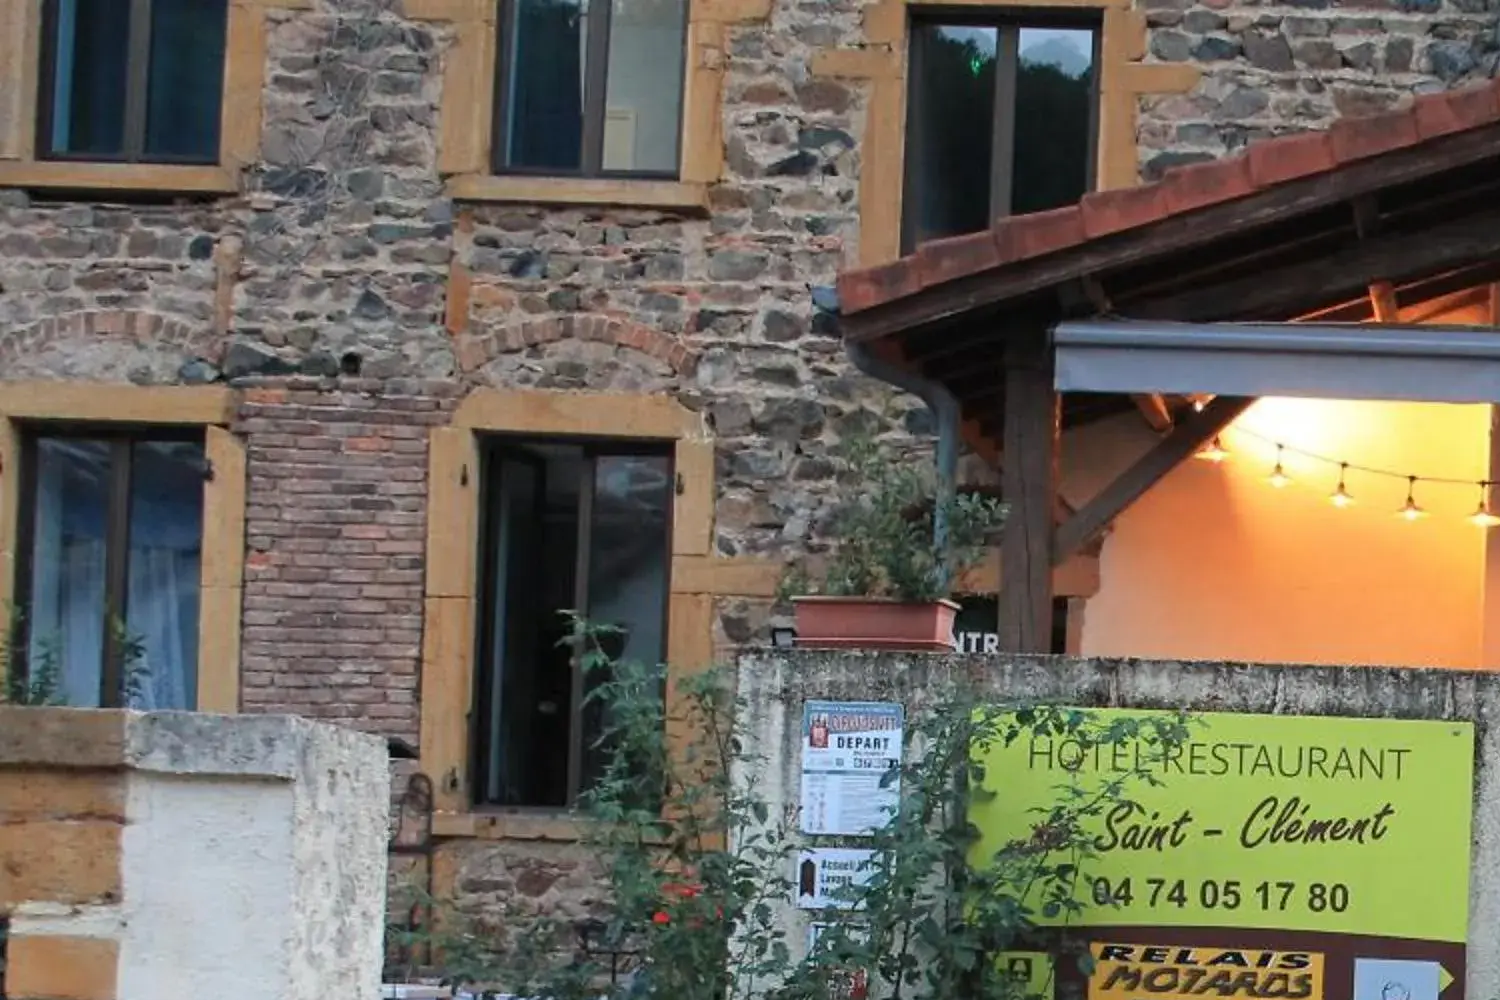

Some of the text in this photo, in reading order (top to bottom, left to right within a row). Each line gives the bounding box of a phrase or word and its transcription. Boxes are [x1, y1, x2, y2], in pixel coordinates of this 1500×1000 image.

[1028, 738, 1412, 781] HOTEL RESTAURANT
[1094, 799, 1193, 852] Saint
[1239, 796, 1395, 850] Clément
[1092, 877, 1350, 913] 04 74 05 17 80
[1100, 945, 1311, 969] RELAIS
[1100, 966, 1313, 998] MOTARDS
